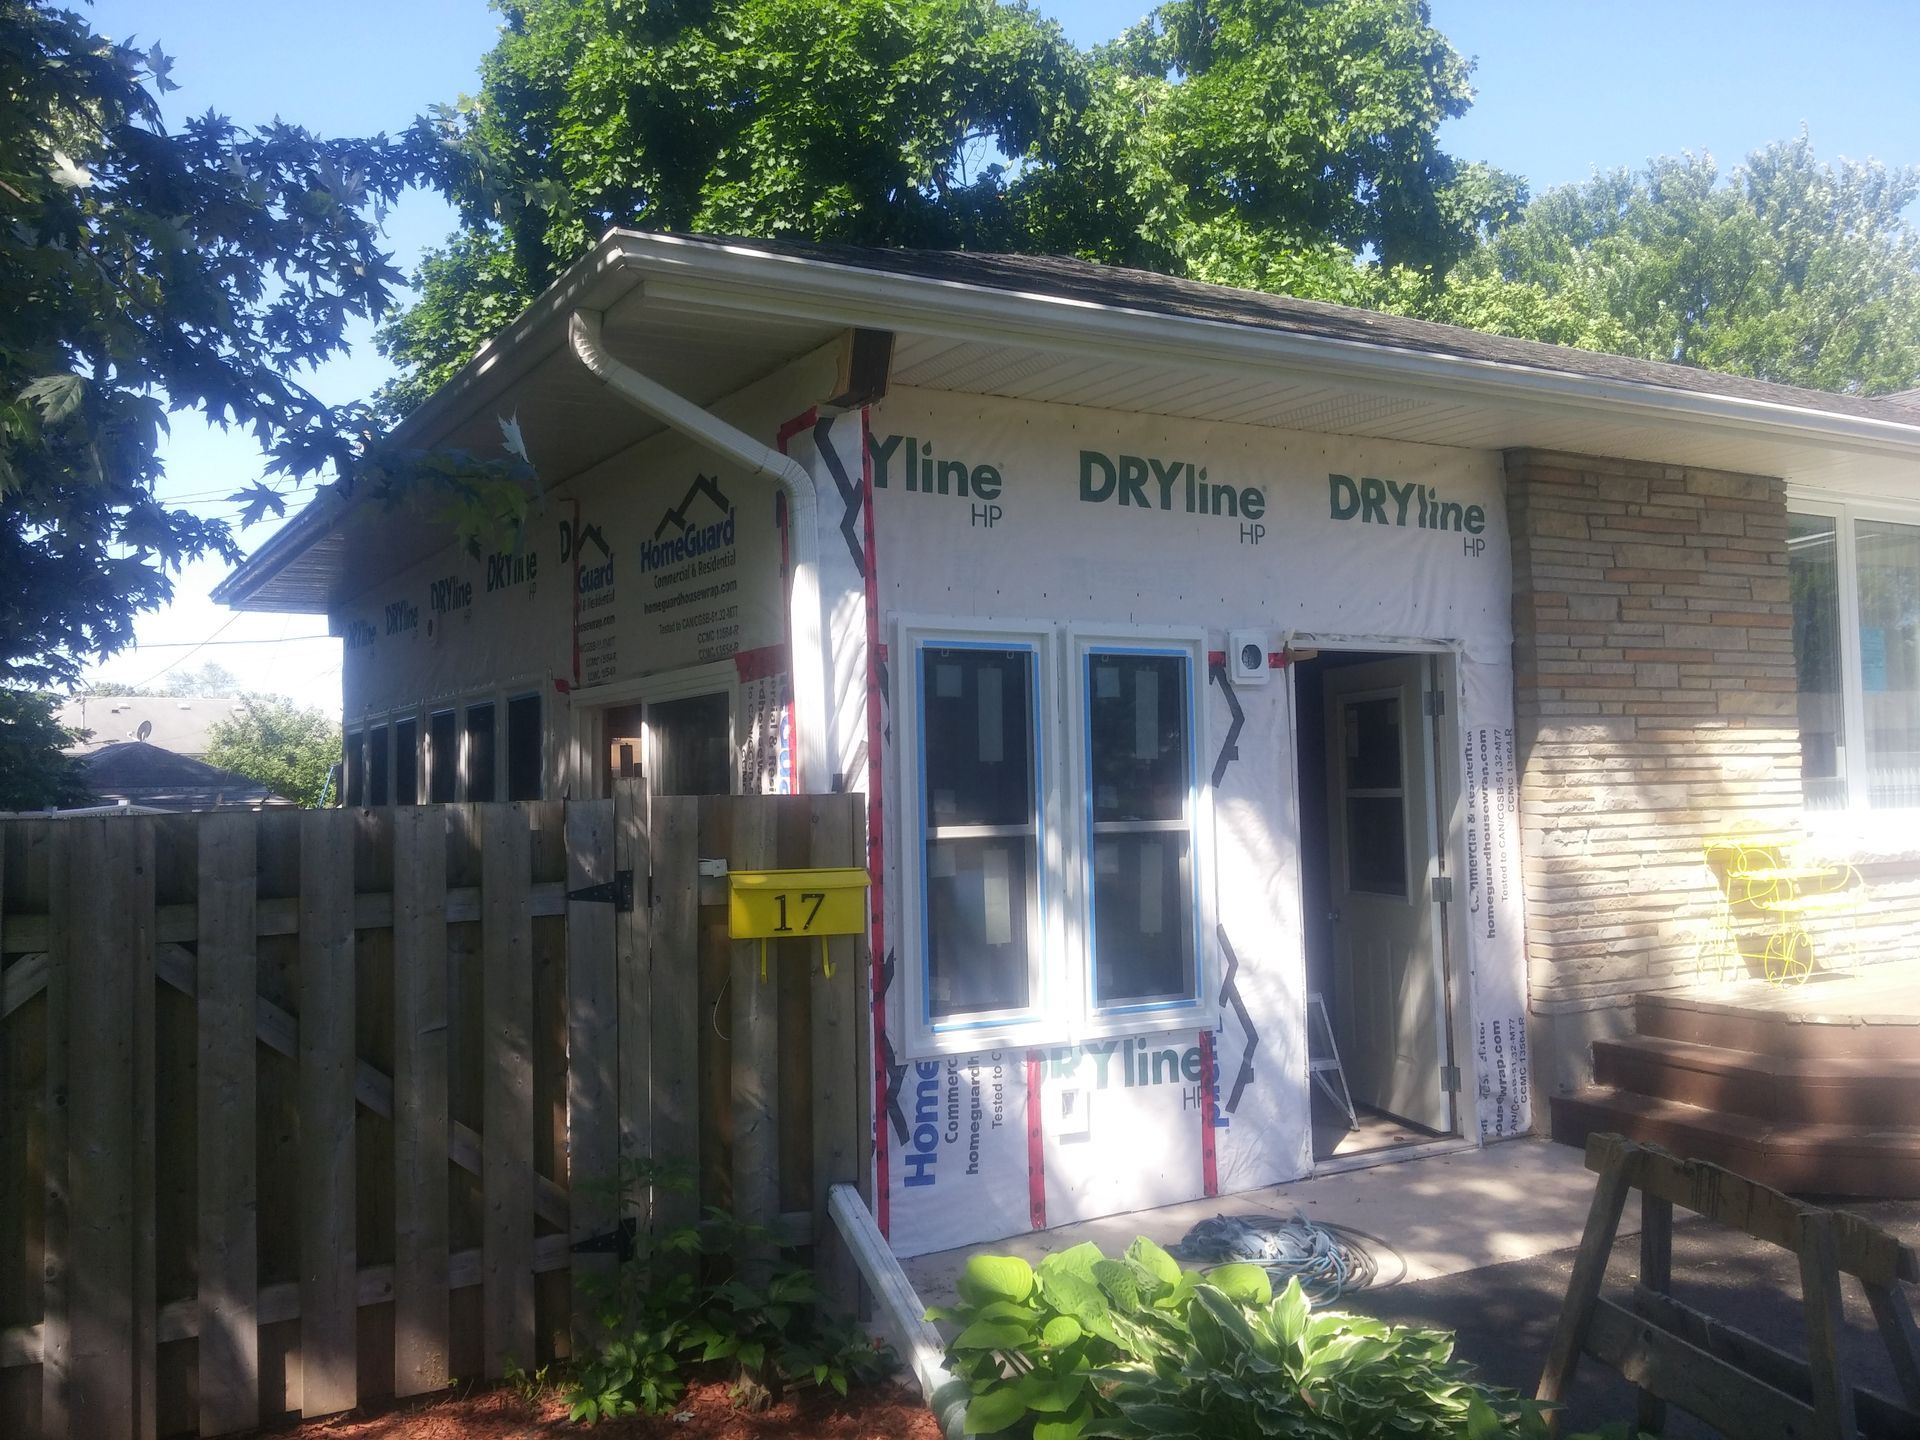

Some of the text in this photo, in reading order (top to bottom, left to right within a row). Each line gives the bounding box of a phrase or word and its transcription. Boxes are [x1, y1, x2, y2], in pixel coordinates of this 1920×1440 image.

[869, 435, 1001, 500] Yline
[1080, 450, 1266, 519] DRYline
[971, 503, 1002, 529] HP
[1329, 473, 1485, 534] DRYline
[640, 507, 735, 573] HomeGuard
[1239, 523, 1266, 545] HP
[1463, 537, 1486, 558] HP
[654, 562, 690, 590] Commercial
[698, 549, 736, 577] Residential
[430, 575, 472, 614] DRYline
[644, 580, 737, 615] homeguardhousewrap.com
[1479, 730, 1496, 938] homeguardhousewrap.com
[1501, 866, 1509, 903] Tested
[774, 893, 825, 932] 17
[992, 1066, 1003, 1082] to
[904, 1060, 939, 1187] Home
[966, 1056, 983, 1176] homeguardh
[992, 1084, 1003, 1130] Tested
